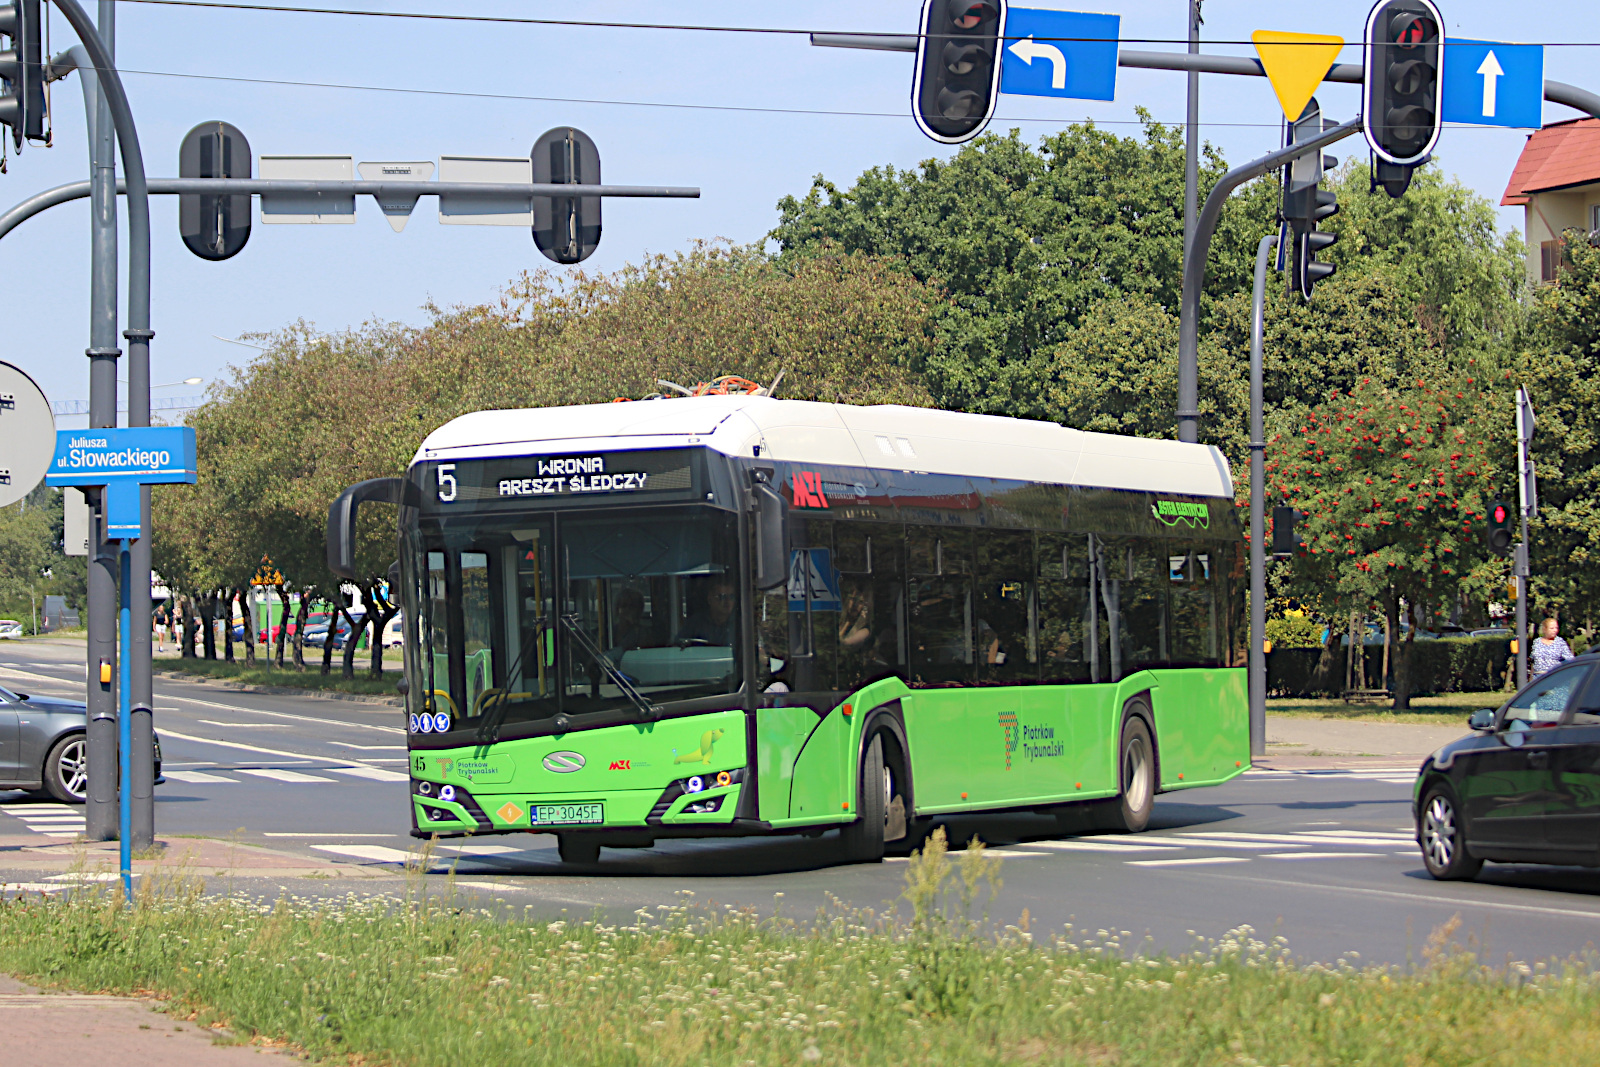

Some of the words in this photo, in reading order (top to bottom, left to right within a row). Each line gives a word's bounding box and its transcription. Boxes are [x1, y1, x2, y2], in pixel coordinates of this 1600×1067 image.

[68, 437, 108, 449] Juliusza
[57, 457, 69, 468] ul.
[69, 447, 170, 469] Słowackiego
[537, 457, 604, 476] WRONIA
[437, 463, 457, 503] 5
[498, 477, 566, 496] ARESZT
[569, 473, 647, 492] ŚLEDCZY
[1023, 723, 1055, 740] Piotrków
[1023, 740, 1064, 762] Trybunalski
[413, 756, 426, 772] 45
[457, 761, 488, 769] Piotrków
[457, 768, 499, 776] Trybunalski
[608, 759, 631, 771] MZK
[539, 806, 556, 820] EP
[560, 805, 599, 820] 3045F
